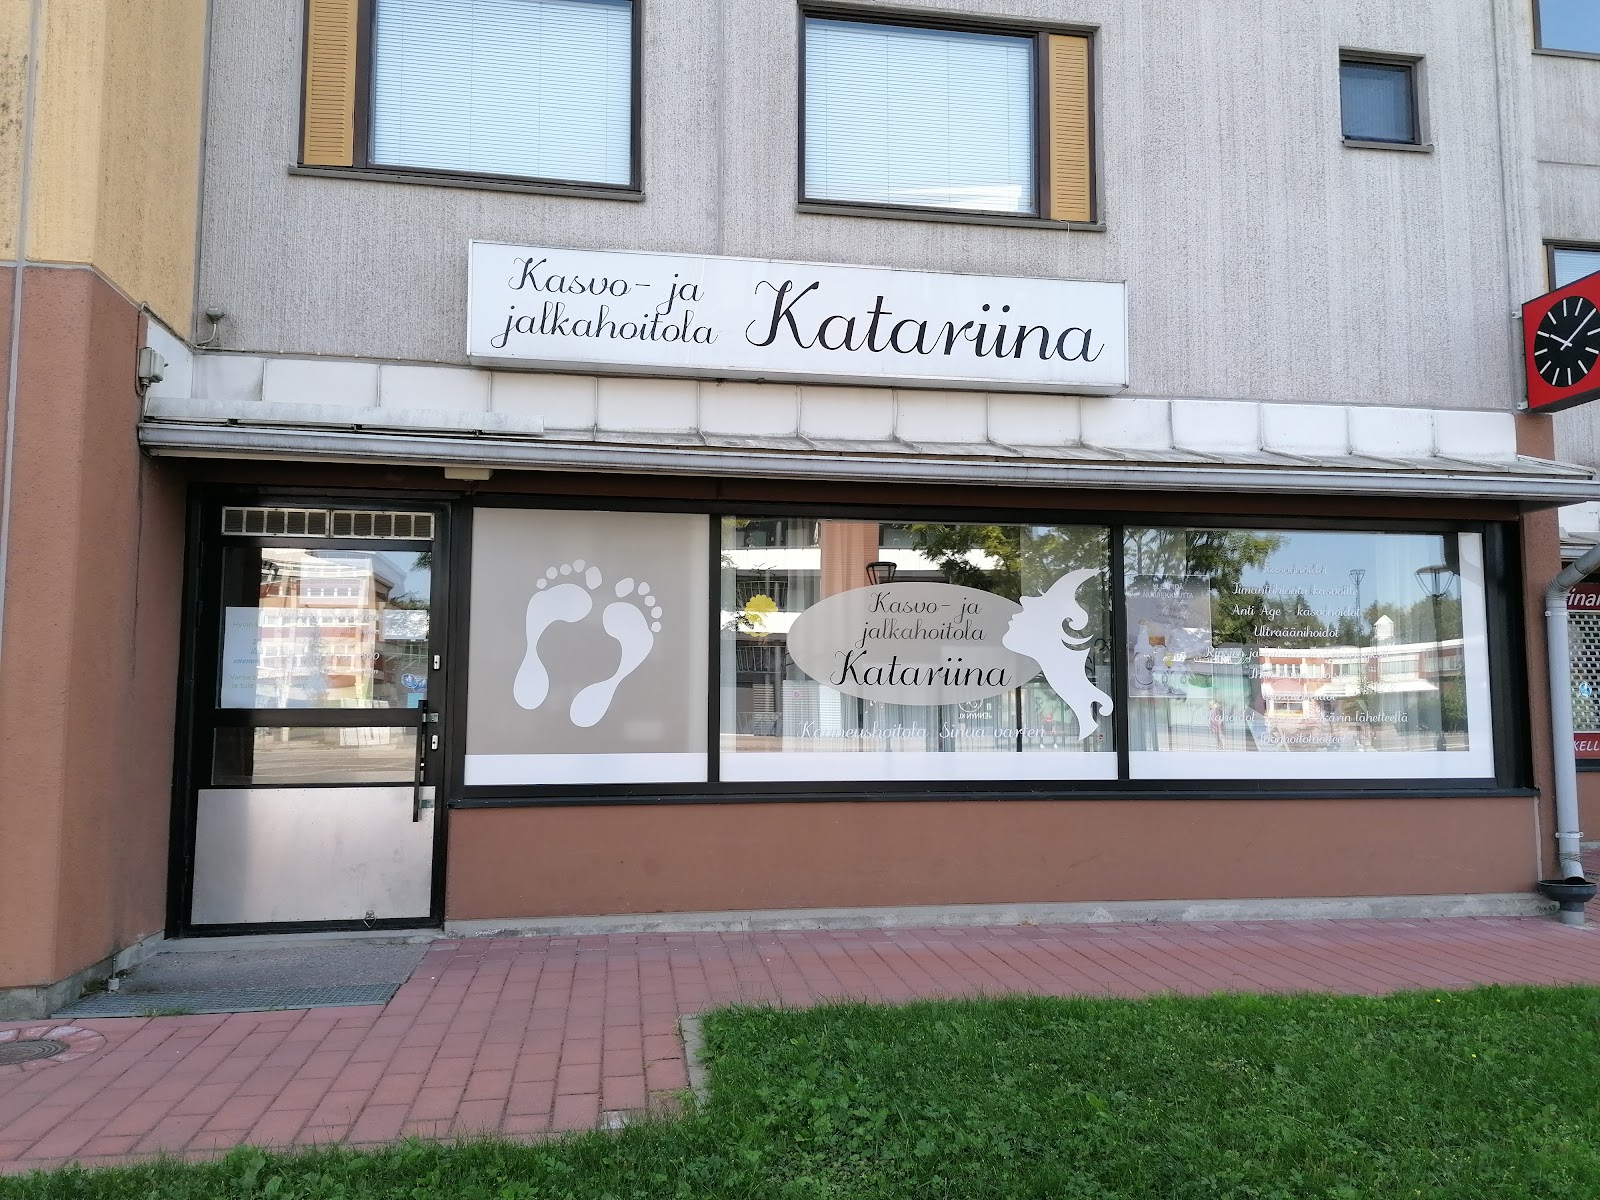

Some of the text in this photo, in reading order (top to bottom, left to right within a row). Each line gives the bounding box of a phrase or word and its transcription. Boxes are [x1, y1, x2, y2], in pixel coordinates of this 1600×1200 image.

[508, 256, 704, 315] Kasvo- ja
[490, 300, 719, 349] jalkahoitola
[745, 279, 1105, 363] Katariina
[867, 591, 982, 624] Kasvo- ja
[1231, 604, 1255, 616] Anti
[1259, 603, 1282, 620] Age
[1297, 604, 1360, 617] kasvohoidot
[854, 617, 988, 650] jalkahoitola
[1254, 624, 1341, 638] Ultraäänihoidot
[829, 649, 1012, 687] Katariina
[796, 720, 1046, 739] Kauneushoitola Sinua varten
[1198, 709, 1256, 722] alkahoidot
[1355, 711, 1409, 724] lähetteellä
